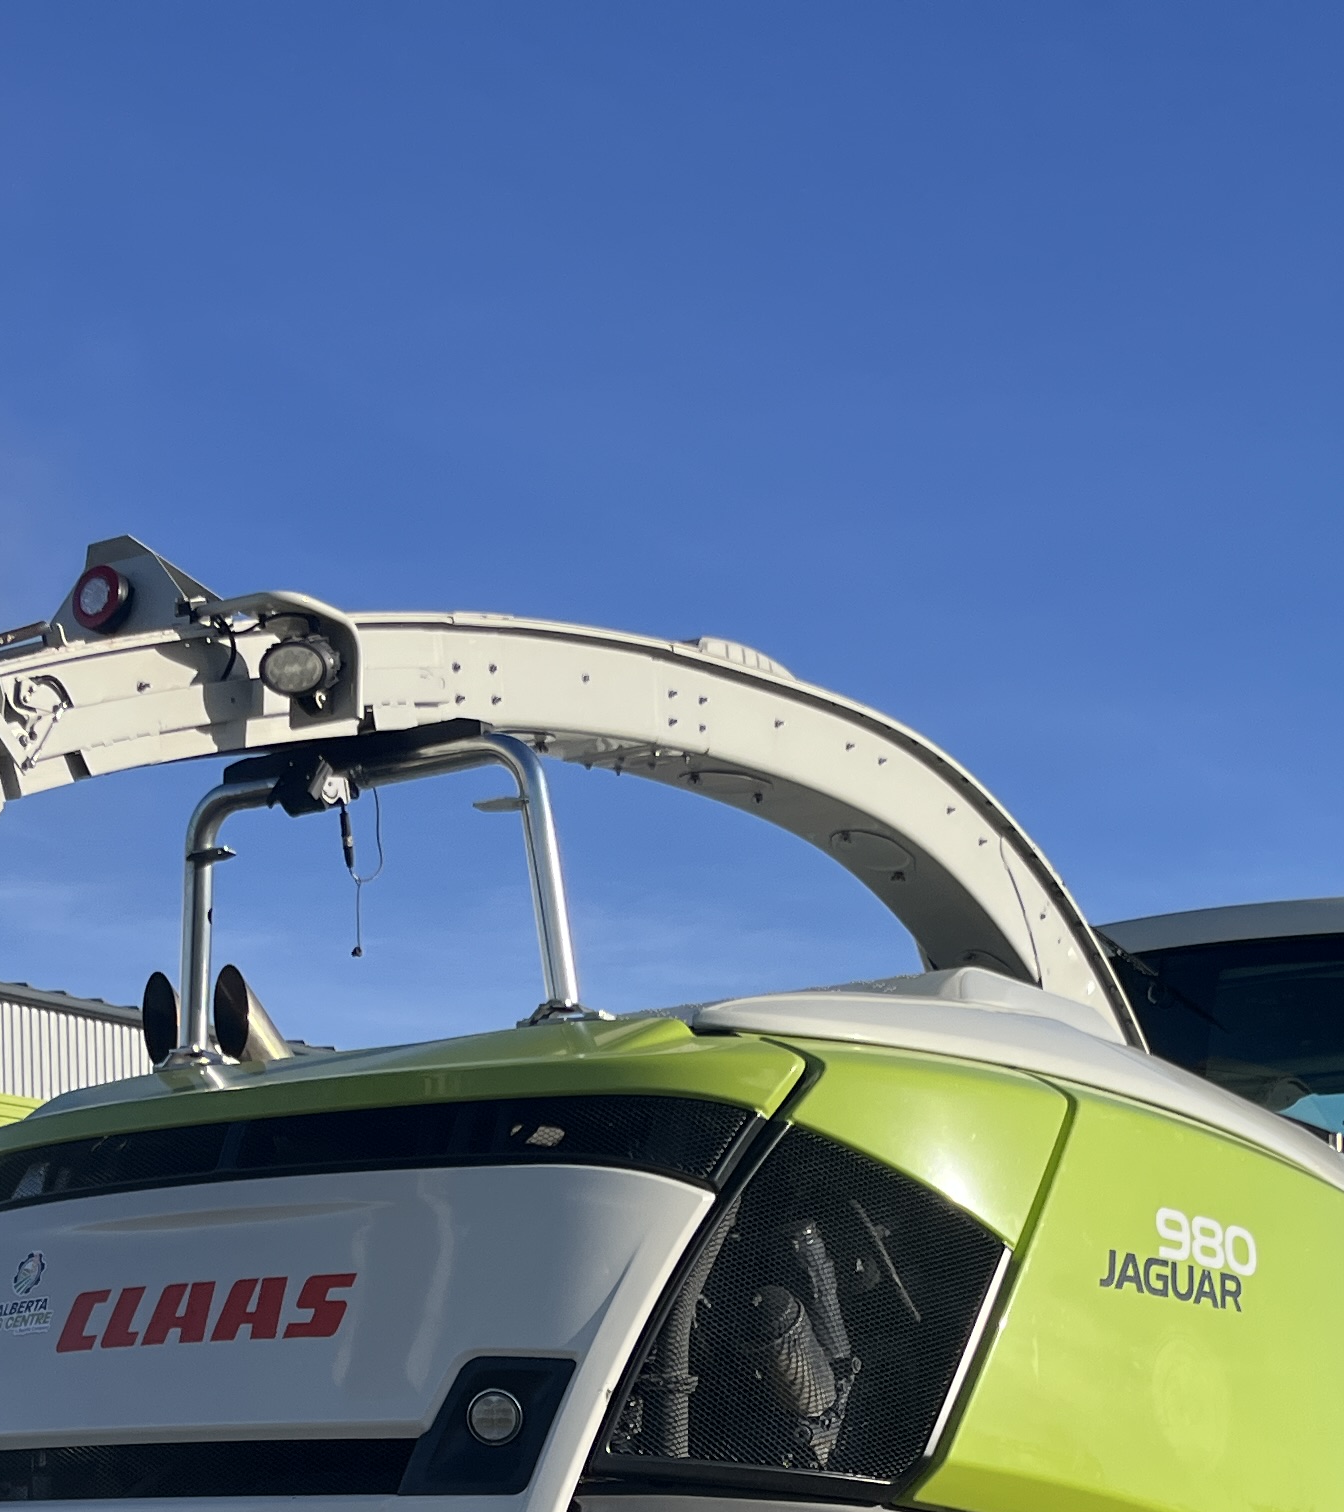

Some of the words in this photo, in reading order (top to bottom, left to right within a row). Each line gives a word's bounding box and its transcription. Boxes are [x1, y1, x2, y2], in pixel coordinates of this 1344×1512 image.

[1156, 1207, 1257, 1276] 980
[56, 1273, 357, 1353] CLAAS
[1099, 1249, 1242, 1313] JAGUAR
[5, 1311, 52, 1329] CENTRE
